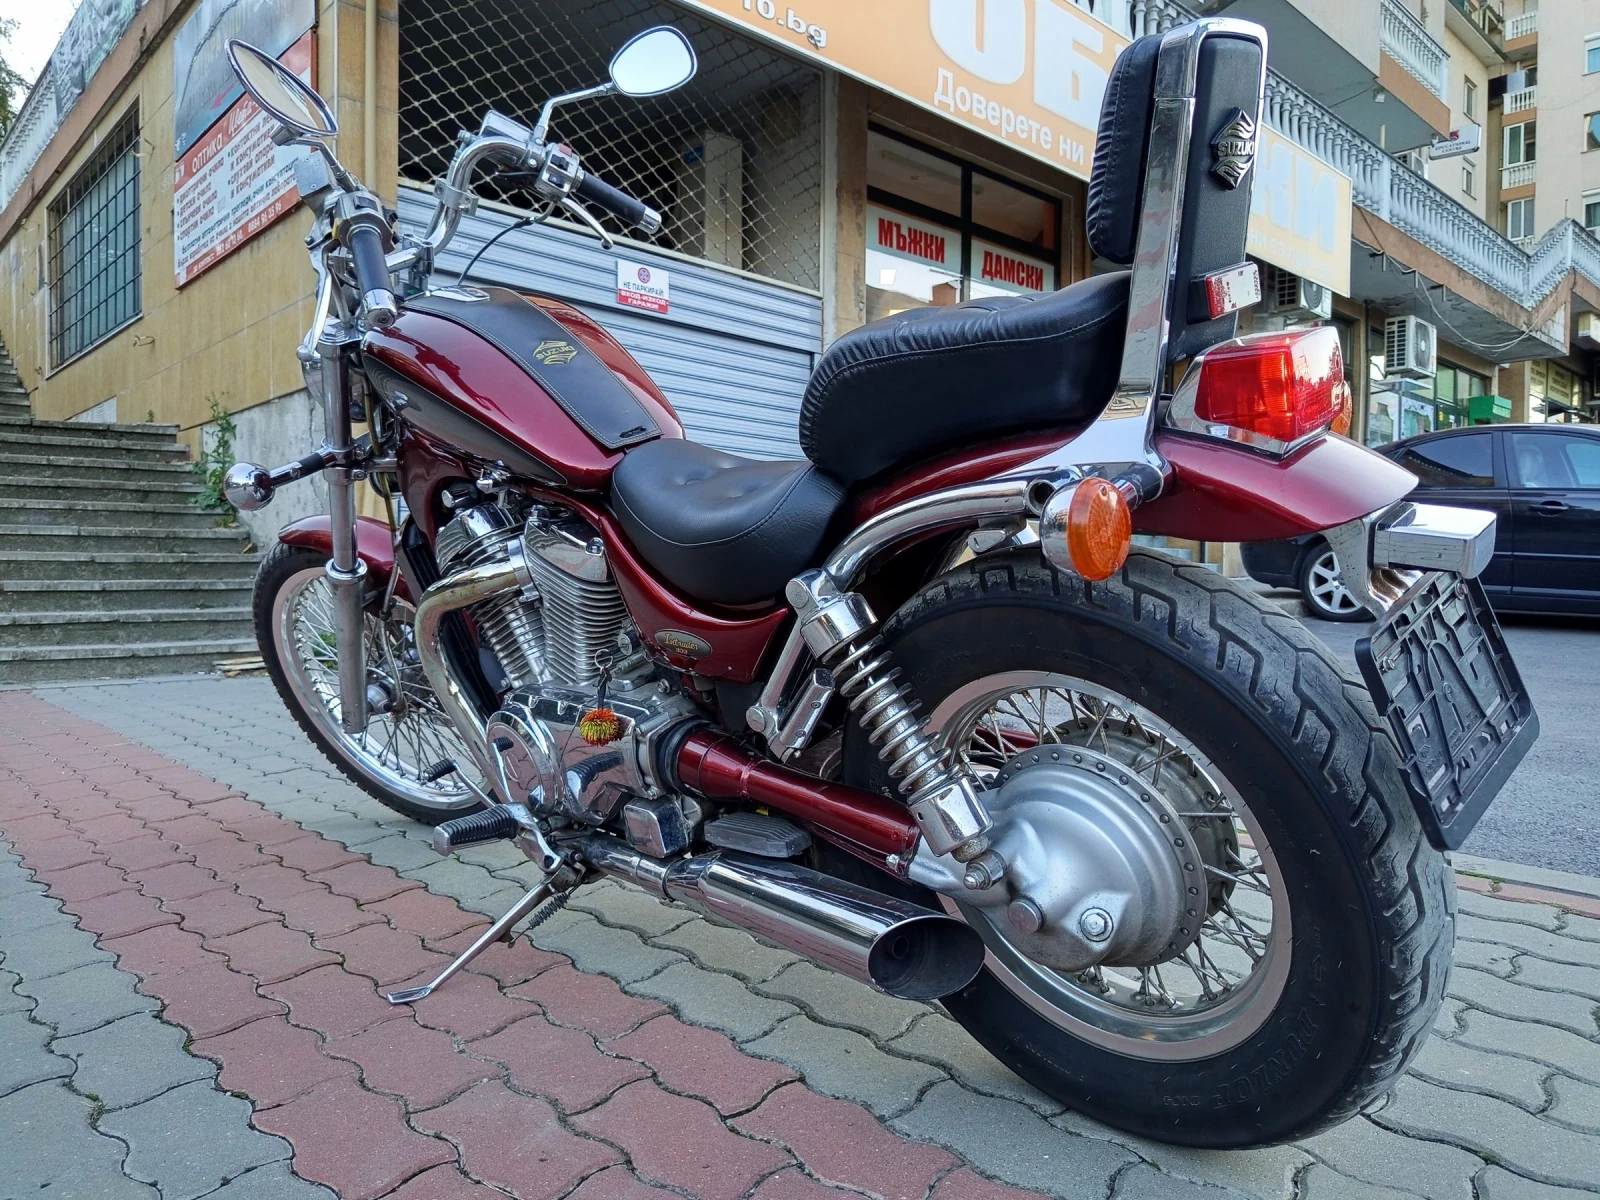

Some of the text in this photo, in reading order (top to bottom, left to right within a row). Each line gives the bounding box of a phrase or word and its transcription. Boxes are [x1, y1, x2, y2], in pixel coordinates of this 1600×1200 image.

[933, 67, 1084, 165] Доверете ни
[1217, 141, 1255, 157] SUZUKI
[878, 217, 945, 264] МЪЖКИ
[623, 281, 631, 290] НЕ
[981, 250, 1043, 291] ДАМСКИ
